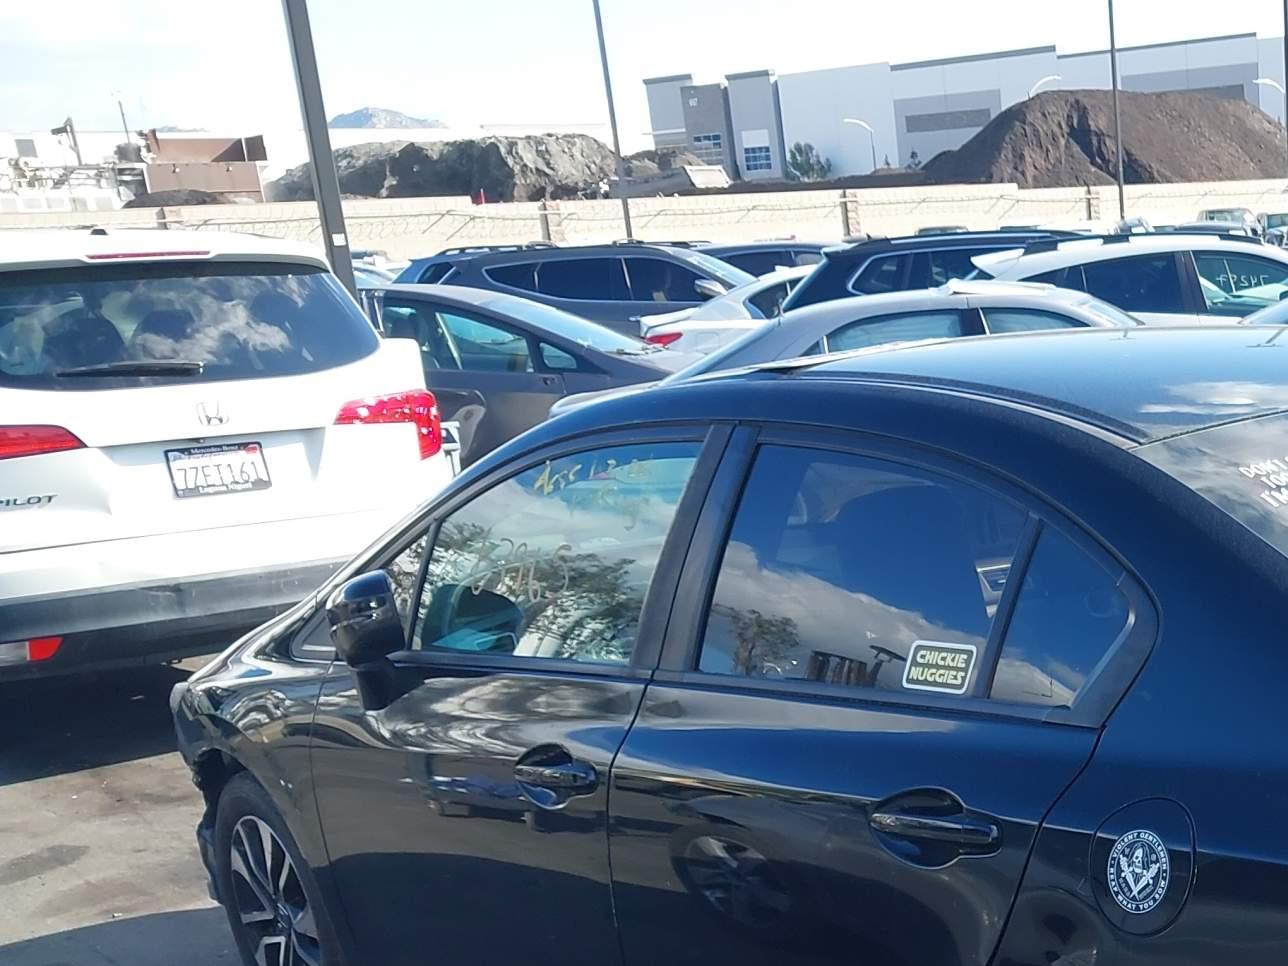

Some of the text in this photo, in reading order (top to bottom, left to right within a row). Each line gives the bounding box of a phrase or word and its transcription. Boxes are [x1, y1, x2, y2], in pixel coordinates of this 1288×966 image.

[916, 650, 968, 668] CHICKIE
[908, 666, 966, 685] NUGGIES
[1112, 832, 1167, 870] VIOLENT GENTLEMEN
[1117, 894, 1137, 910] WHAT
[1138, 900, 1154, 910] YOU
